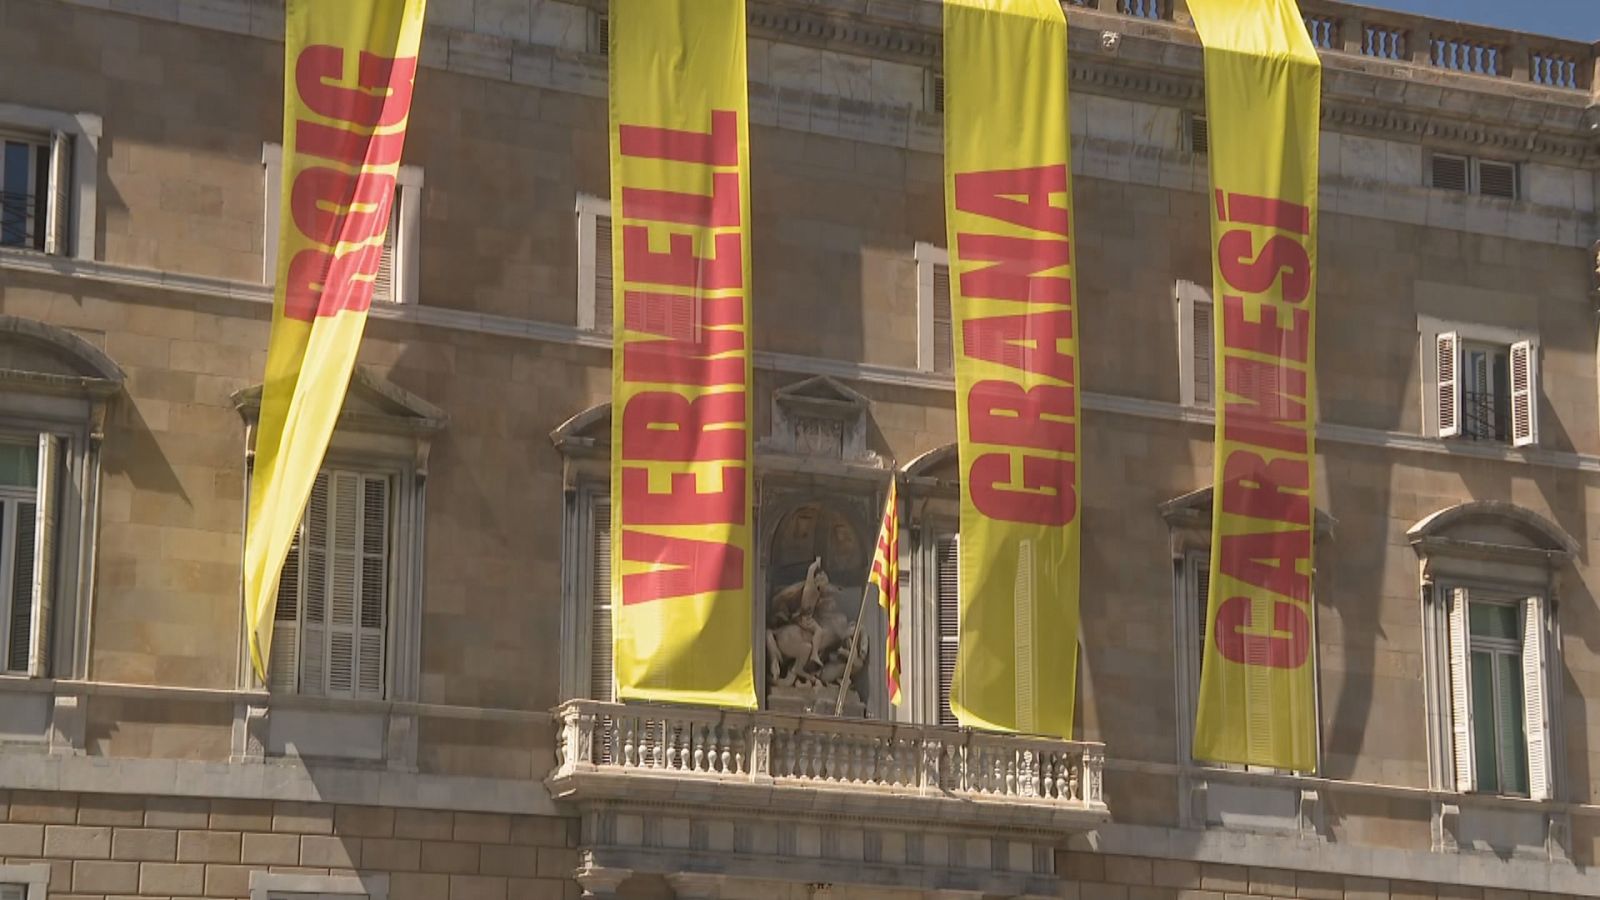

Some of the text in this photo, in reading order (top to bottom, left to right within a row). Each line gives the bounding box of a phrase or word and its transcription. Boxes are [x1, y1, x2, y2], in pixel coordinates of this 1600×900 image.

[284, 44, 417, 323] ROIG
[619, 109, 746, 606] VERMELL
[955, 163, 1077, 528] GRANA
[1214, 187, 1312, 670] CARMESÍ
